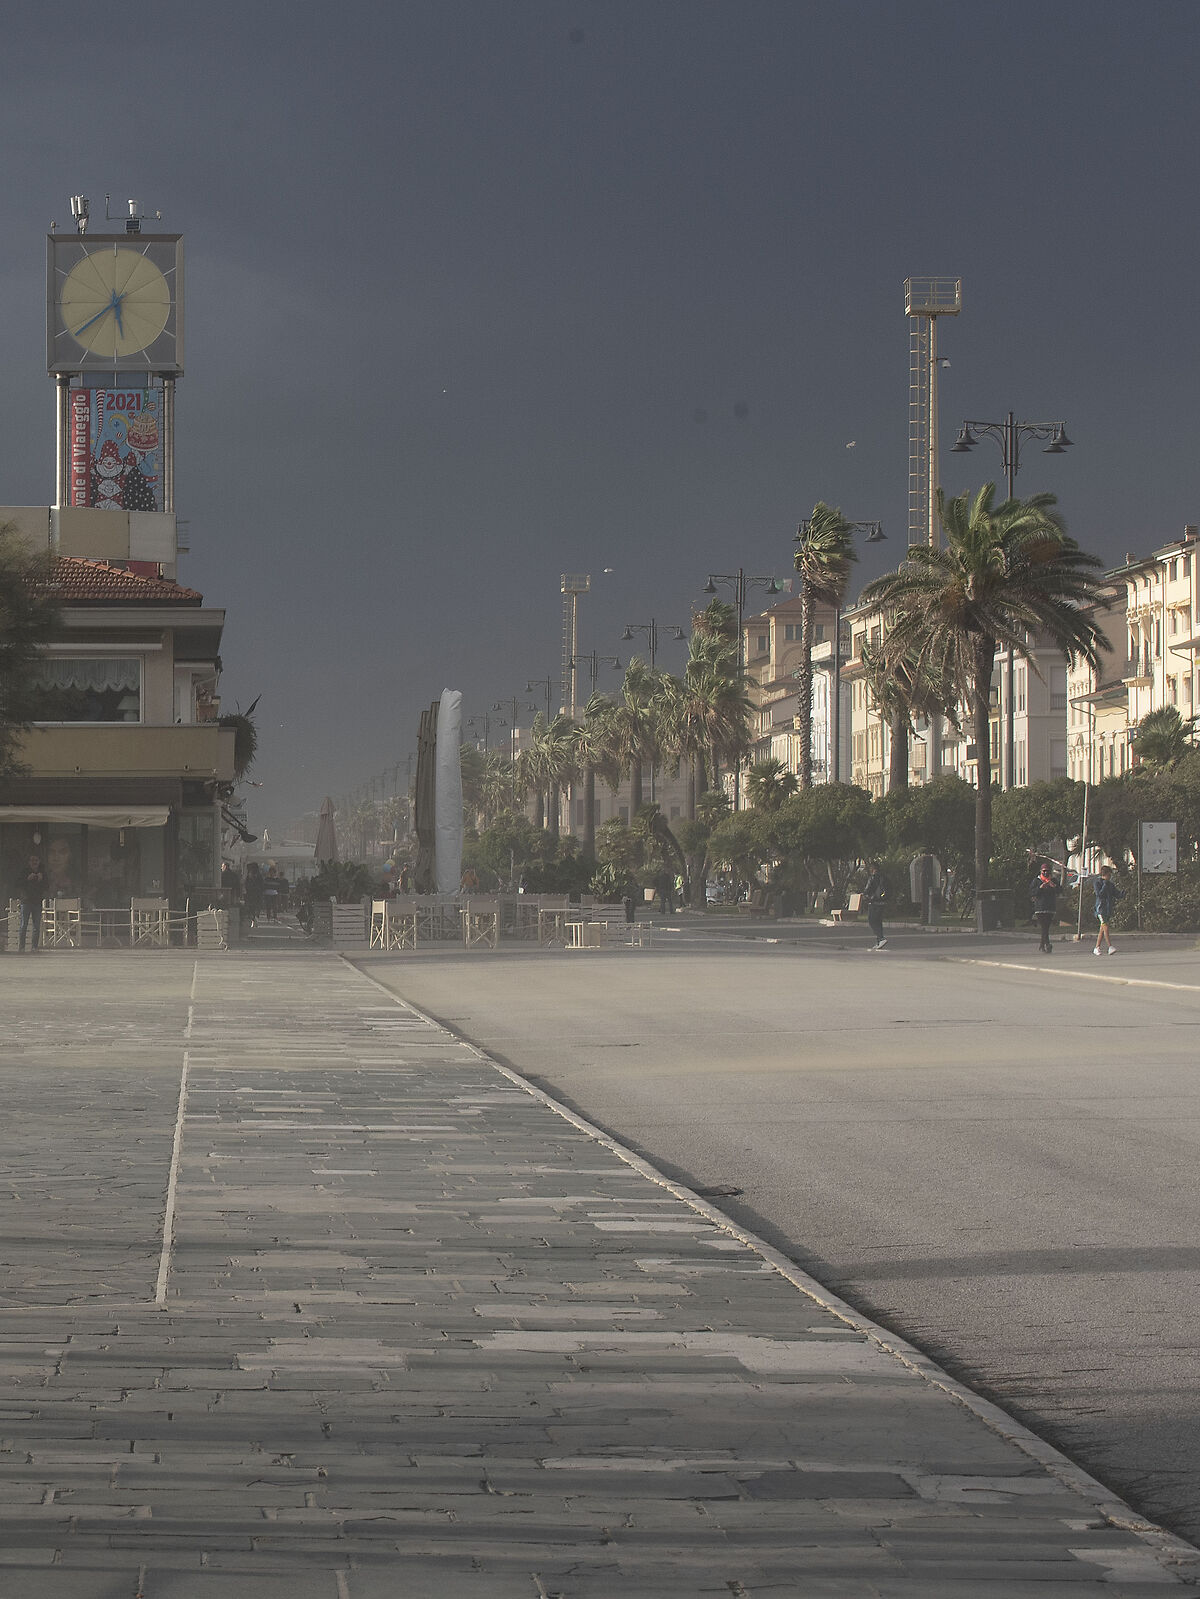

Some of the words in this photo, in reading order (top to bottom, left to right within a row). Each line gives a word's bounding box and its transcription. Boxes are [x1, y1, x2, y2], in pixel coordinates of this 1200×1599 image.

[106, 393, 141, 411] 2021
[73, 394, 89, 458] Viareggio
[73, 461, 86, 474] di
[73, 478, 86, 509] vale
